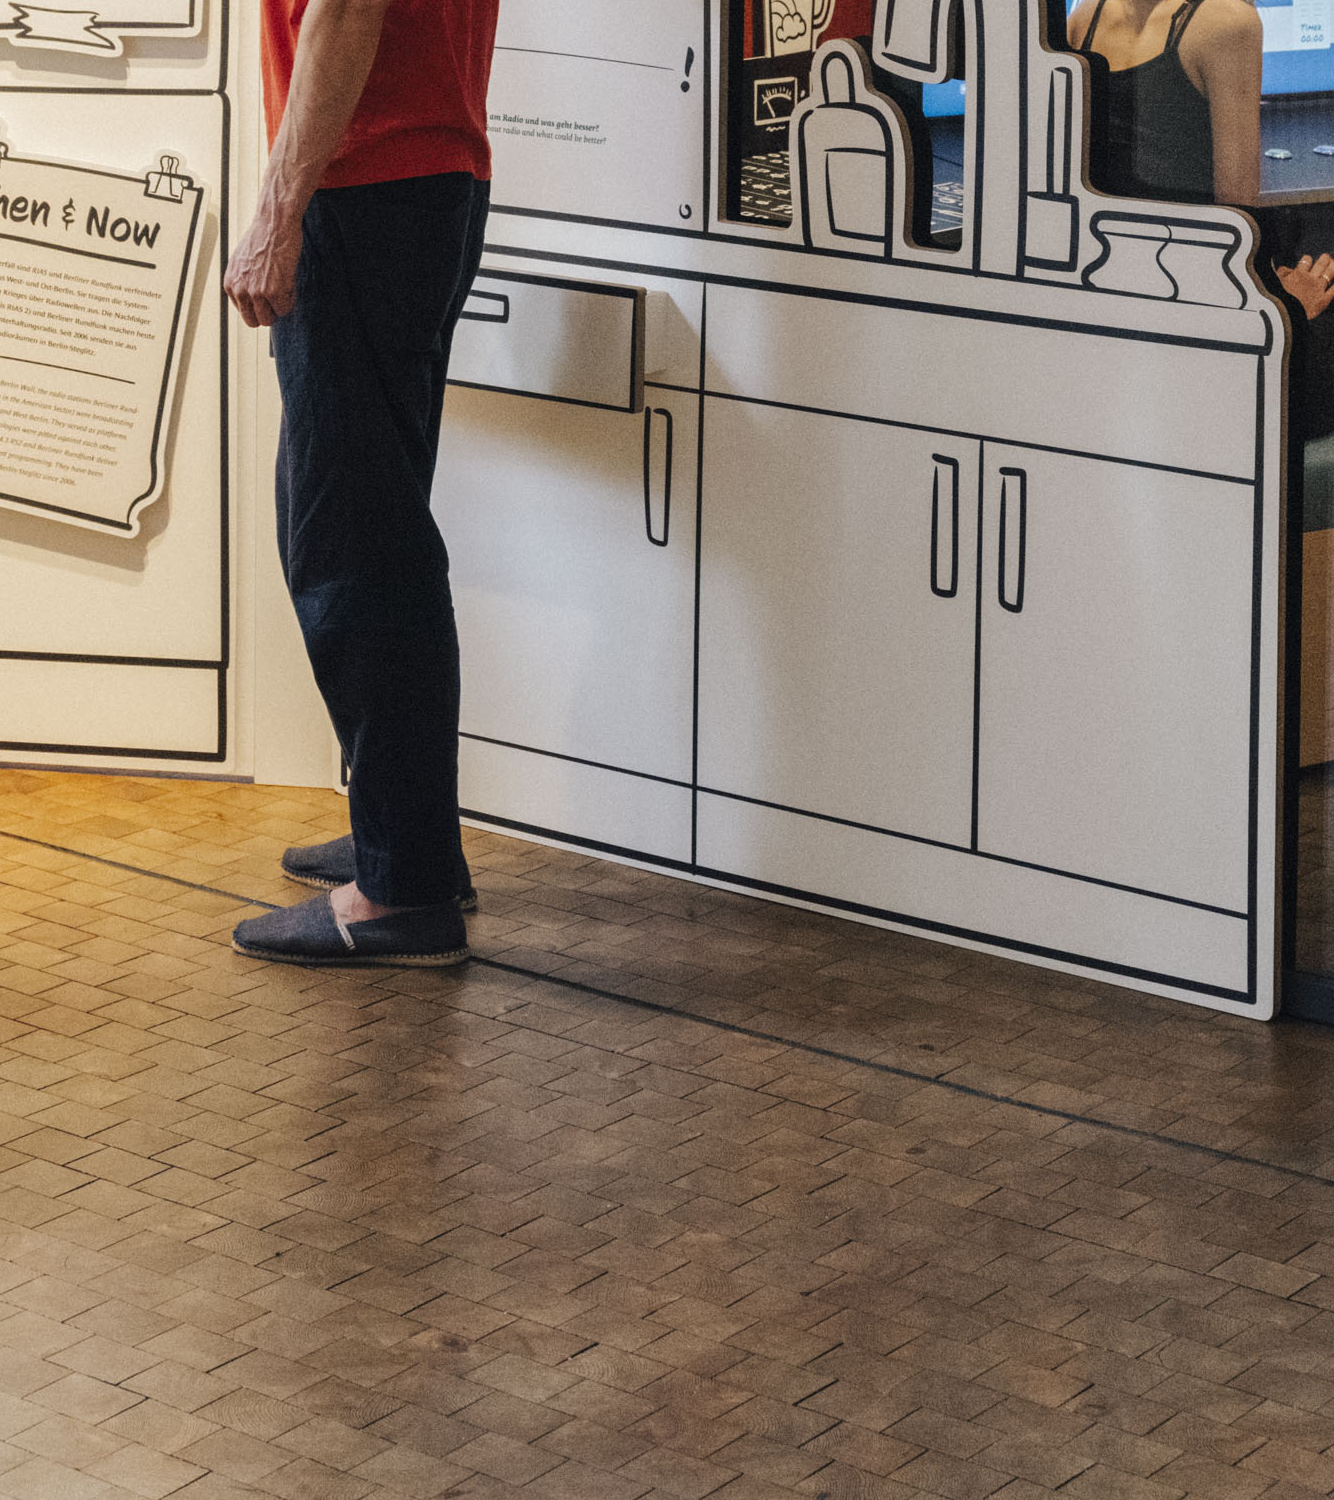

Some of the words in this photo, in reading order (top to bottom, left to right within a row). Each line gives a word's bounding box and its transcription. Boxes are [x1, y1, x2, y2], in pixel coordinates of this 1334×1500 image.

[486, 124, 501, 133] bout
[503, 125, 521, 135] radio
[522, 128, 535, 137] and
[536, 130, 553, 139] what
[554, 132, 572, 141] could
[574, 134, 584, 142] be
[584, 135, 607, 145] better?
[502, 114, 524, 124] Radio
[525, 117, 539, 125] und
[556, 121, 572, 129] geht
[574, 121, 600, 132] besser?
[61, 197, 76, 230] &
[86, 206, 162, 249] Now
[17, 263, 31, 272] sind
[32, 267, 48, 276] RIAS
[49, 270, 62, 279] und
[63, 273, 90, 285] Berliner
[91, 278, 123, 291] Rundfunk
[123, 285, 163, 299] verfeindete
[26, 279, 40, 289] und
[77, 289, 87, 298] Sie
[88, 293, 111, 304] tragen
[111, 296, 123, 306] die
[3, 288, 27, 301] Krieges
[45, 297, 86, 312] Radiowellen
[101, 308, 113, 318] Die
[114, 311, 151, 326] Nachfolger
